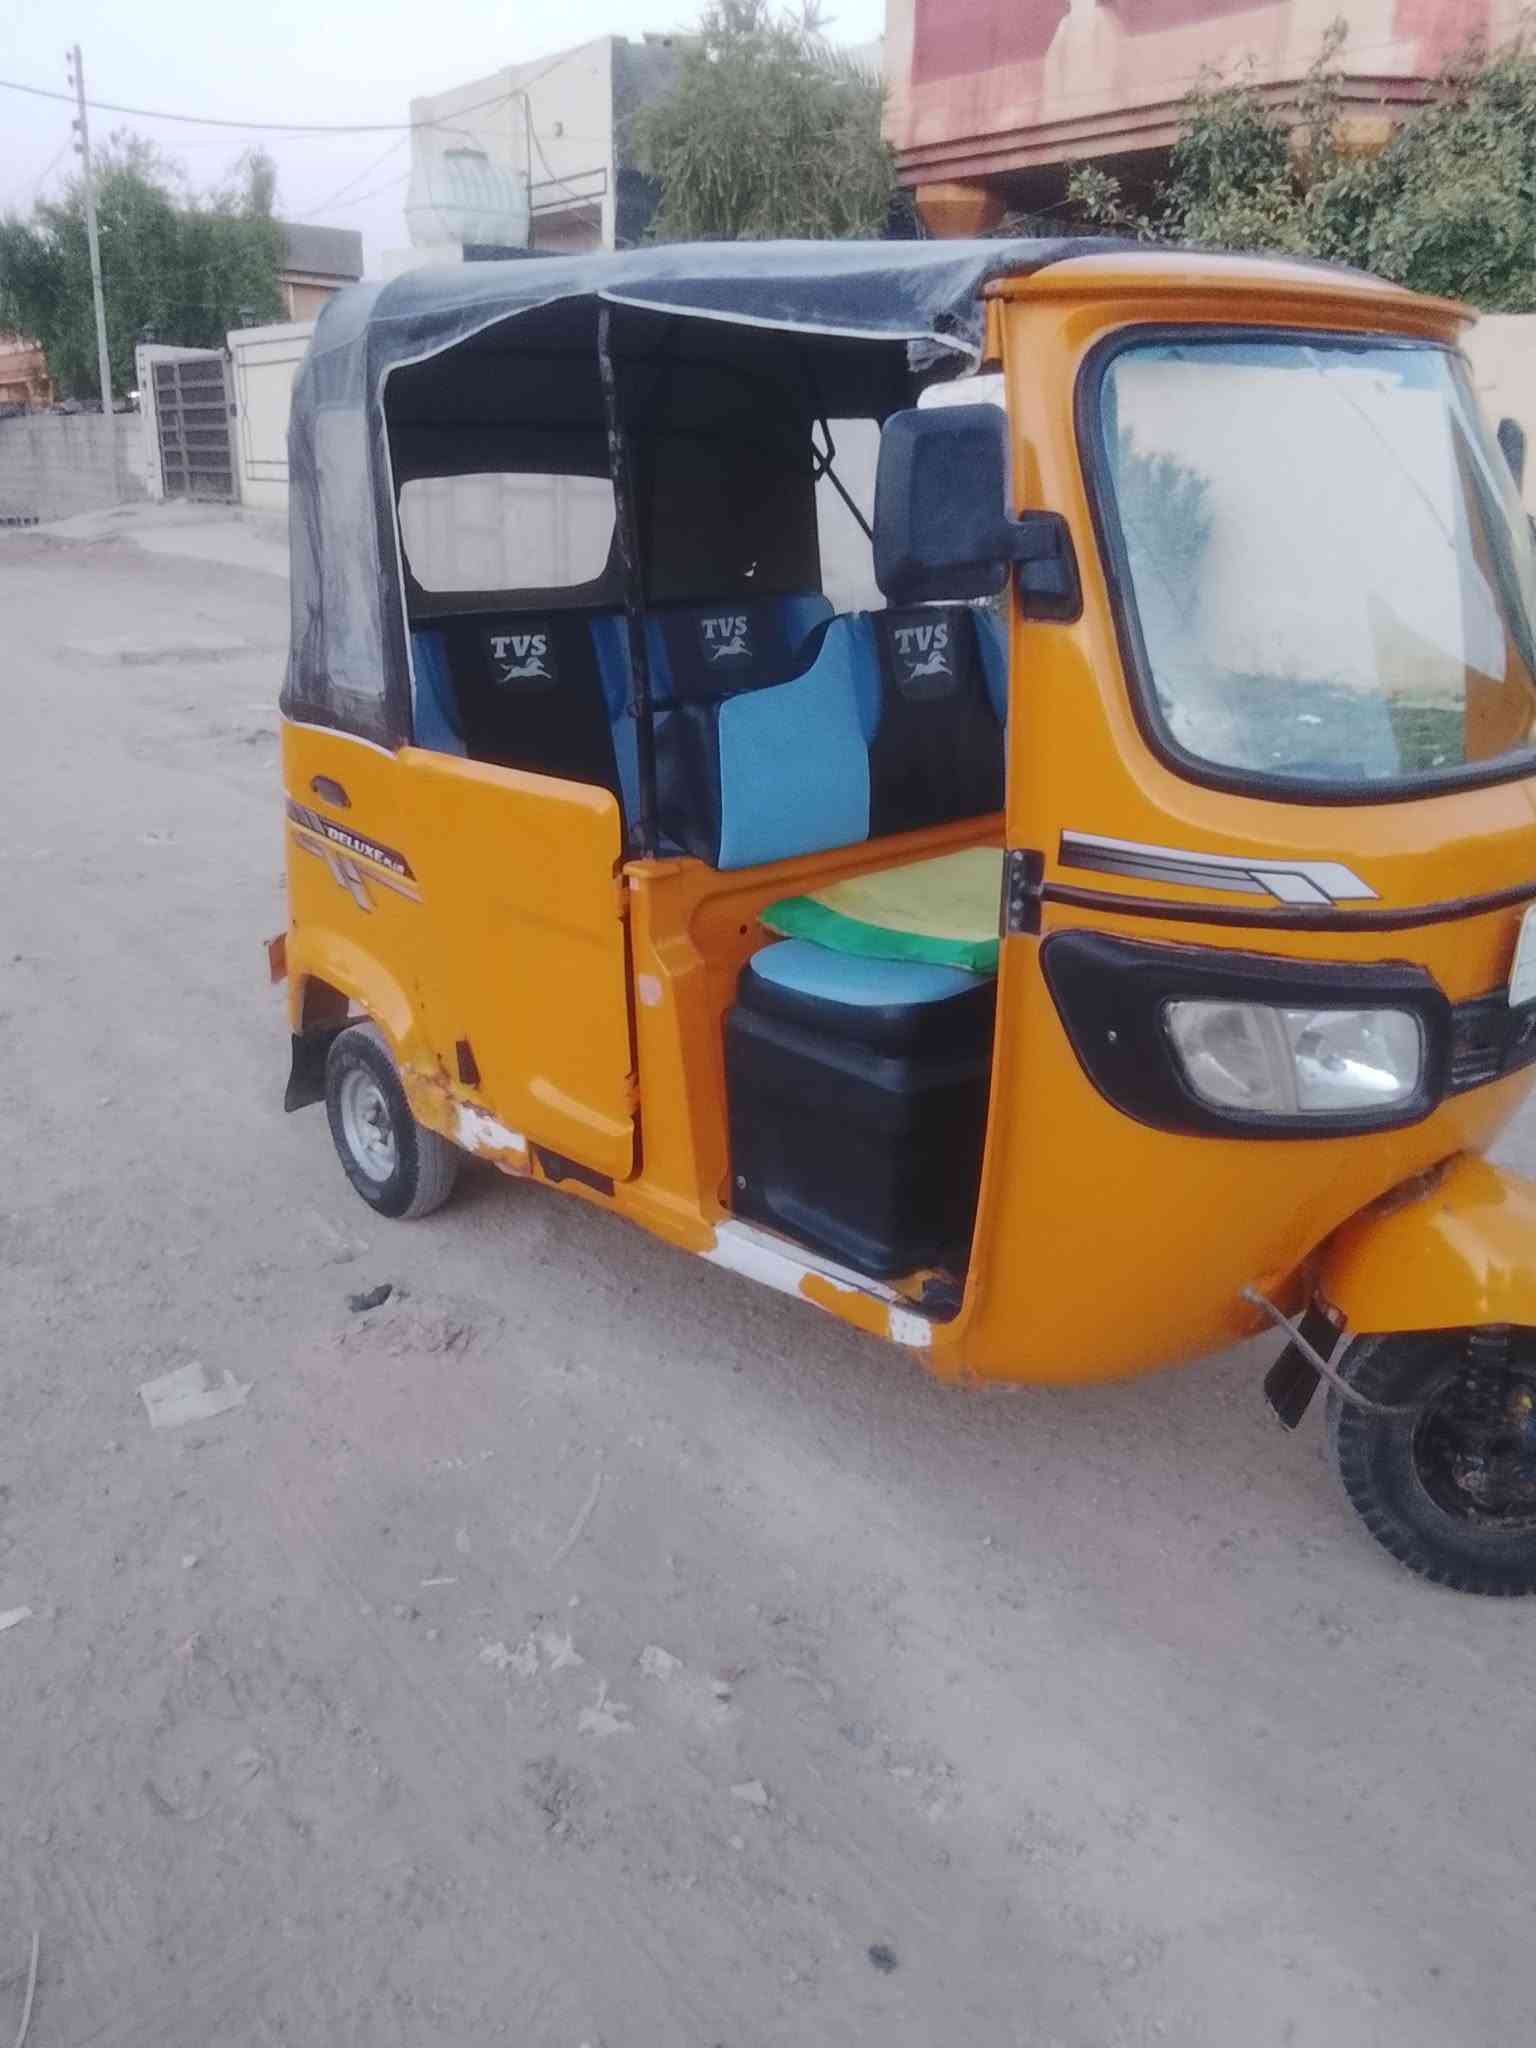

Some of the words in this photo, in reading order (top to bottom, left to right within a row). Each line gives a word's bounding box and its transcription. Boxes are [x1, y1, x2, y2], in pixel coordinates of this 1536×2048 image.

[701, 615, 748, 639] TVS
[895, 623, 949, 655] TVS
[490, 634, 547, 659] TVS
[327, 826, 385, 863] DELUXE
